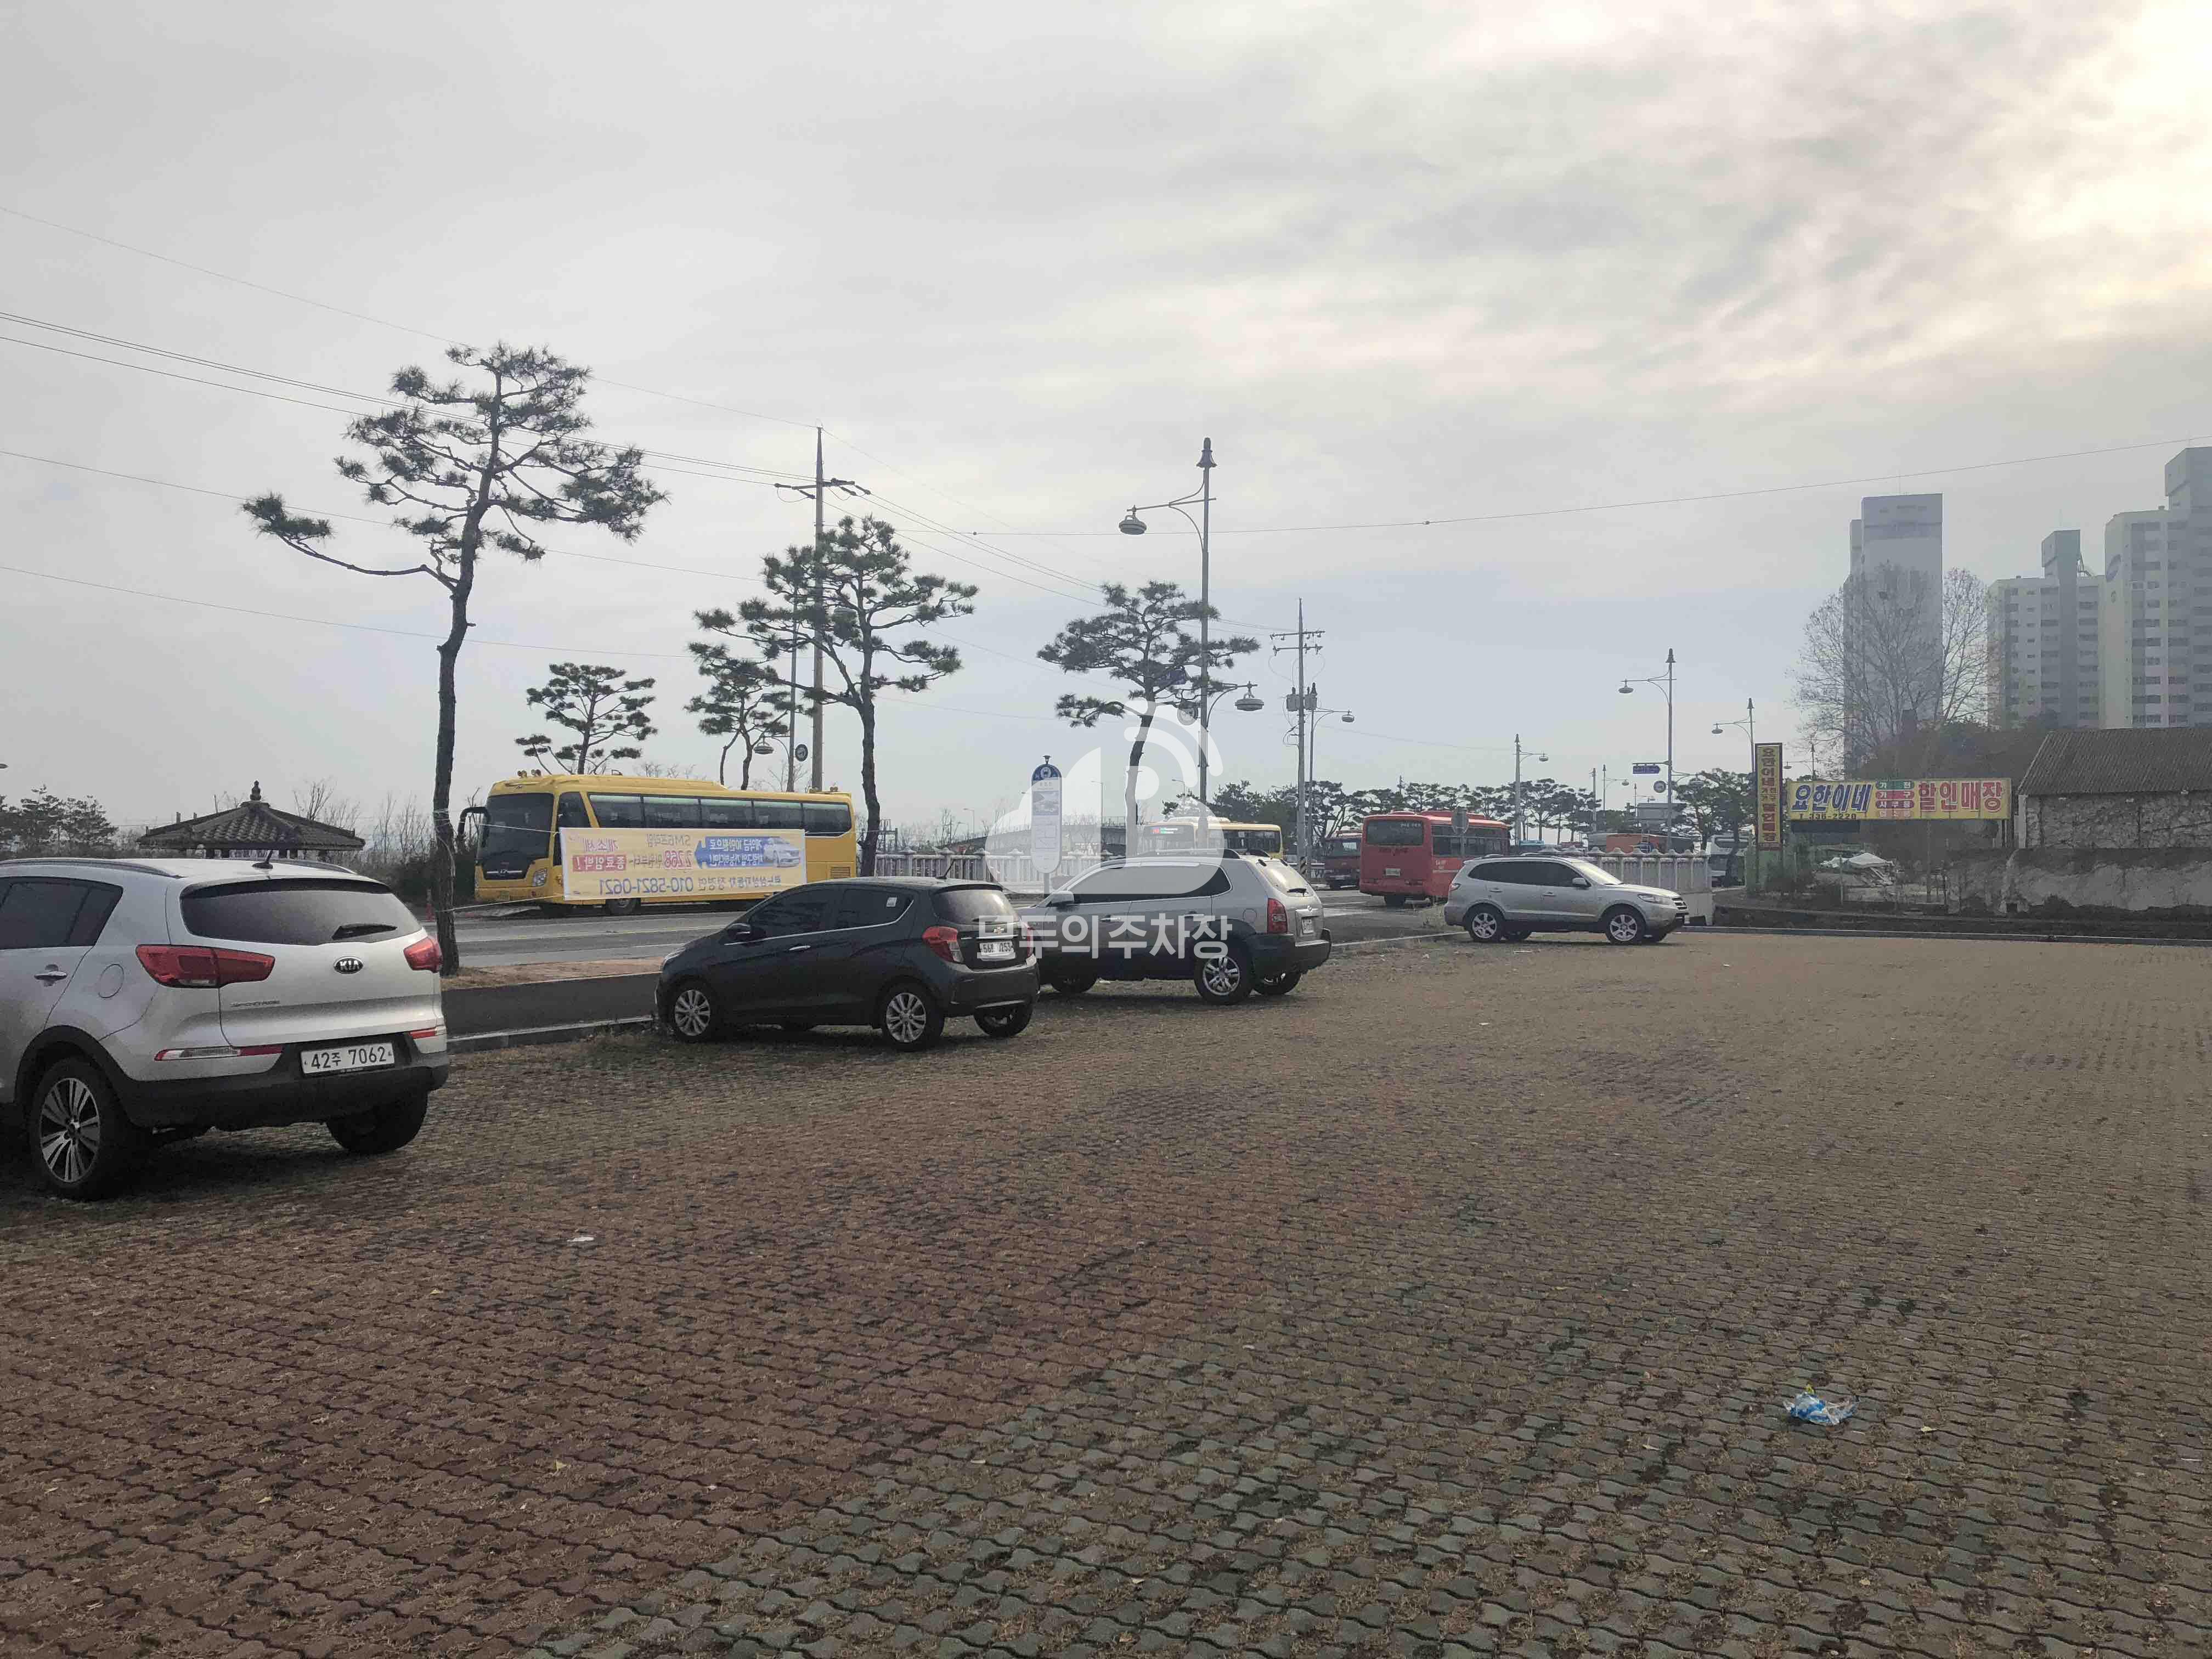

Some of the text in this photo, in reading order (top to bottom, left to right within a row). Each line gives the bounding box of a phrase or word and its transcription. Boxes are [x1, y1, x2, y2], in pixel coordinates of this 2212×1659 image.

[1791, 784, 1873, 812] 요한이네
[1918, 781, 2005, 813] 할인매장
[339, 960, 359, 970] KIA
[311, 1046, 386, 1069] 42주 7062
